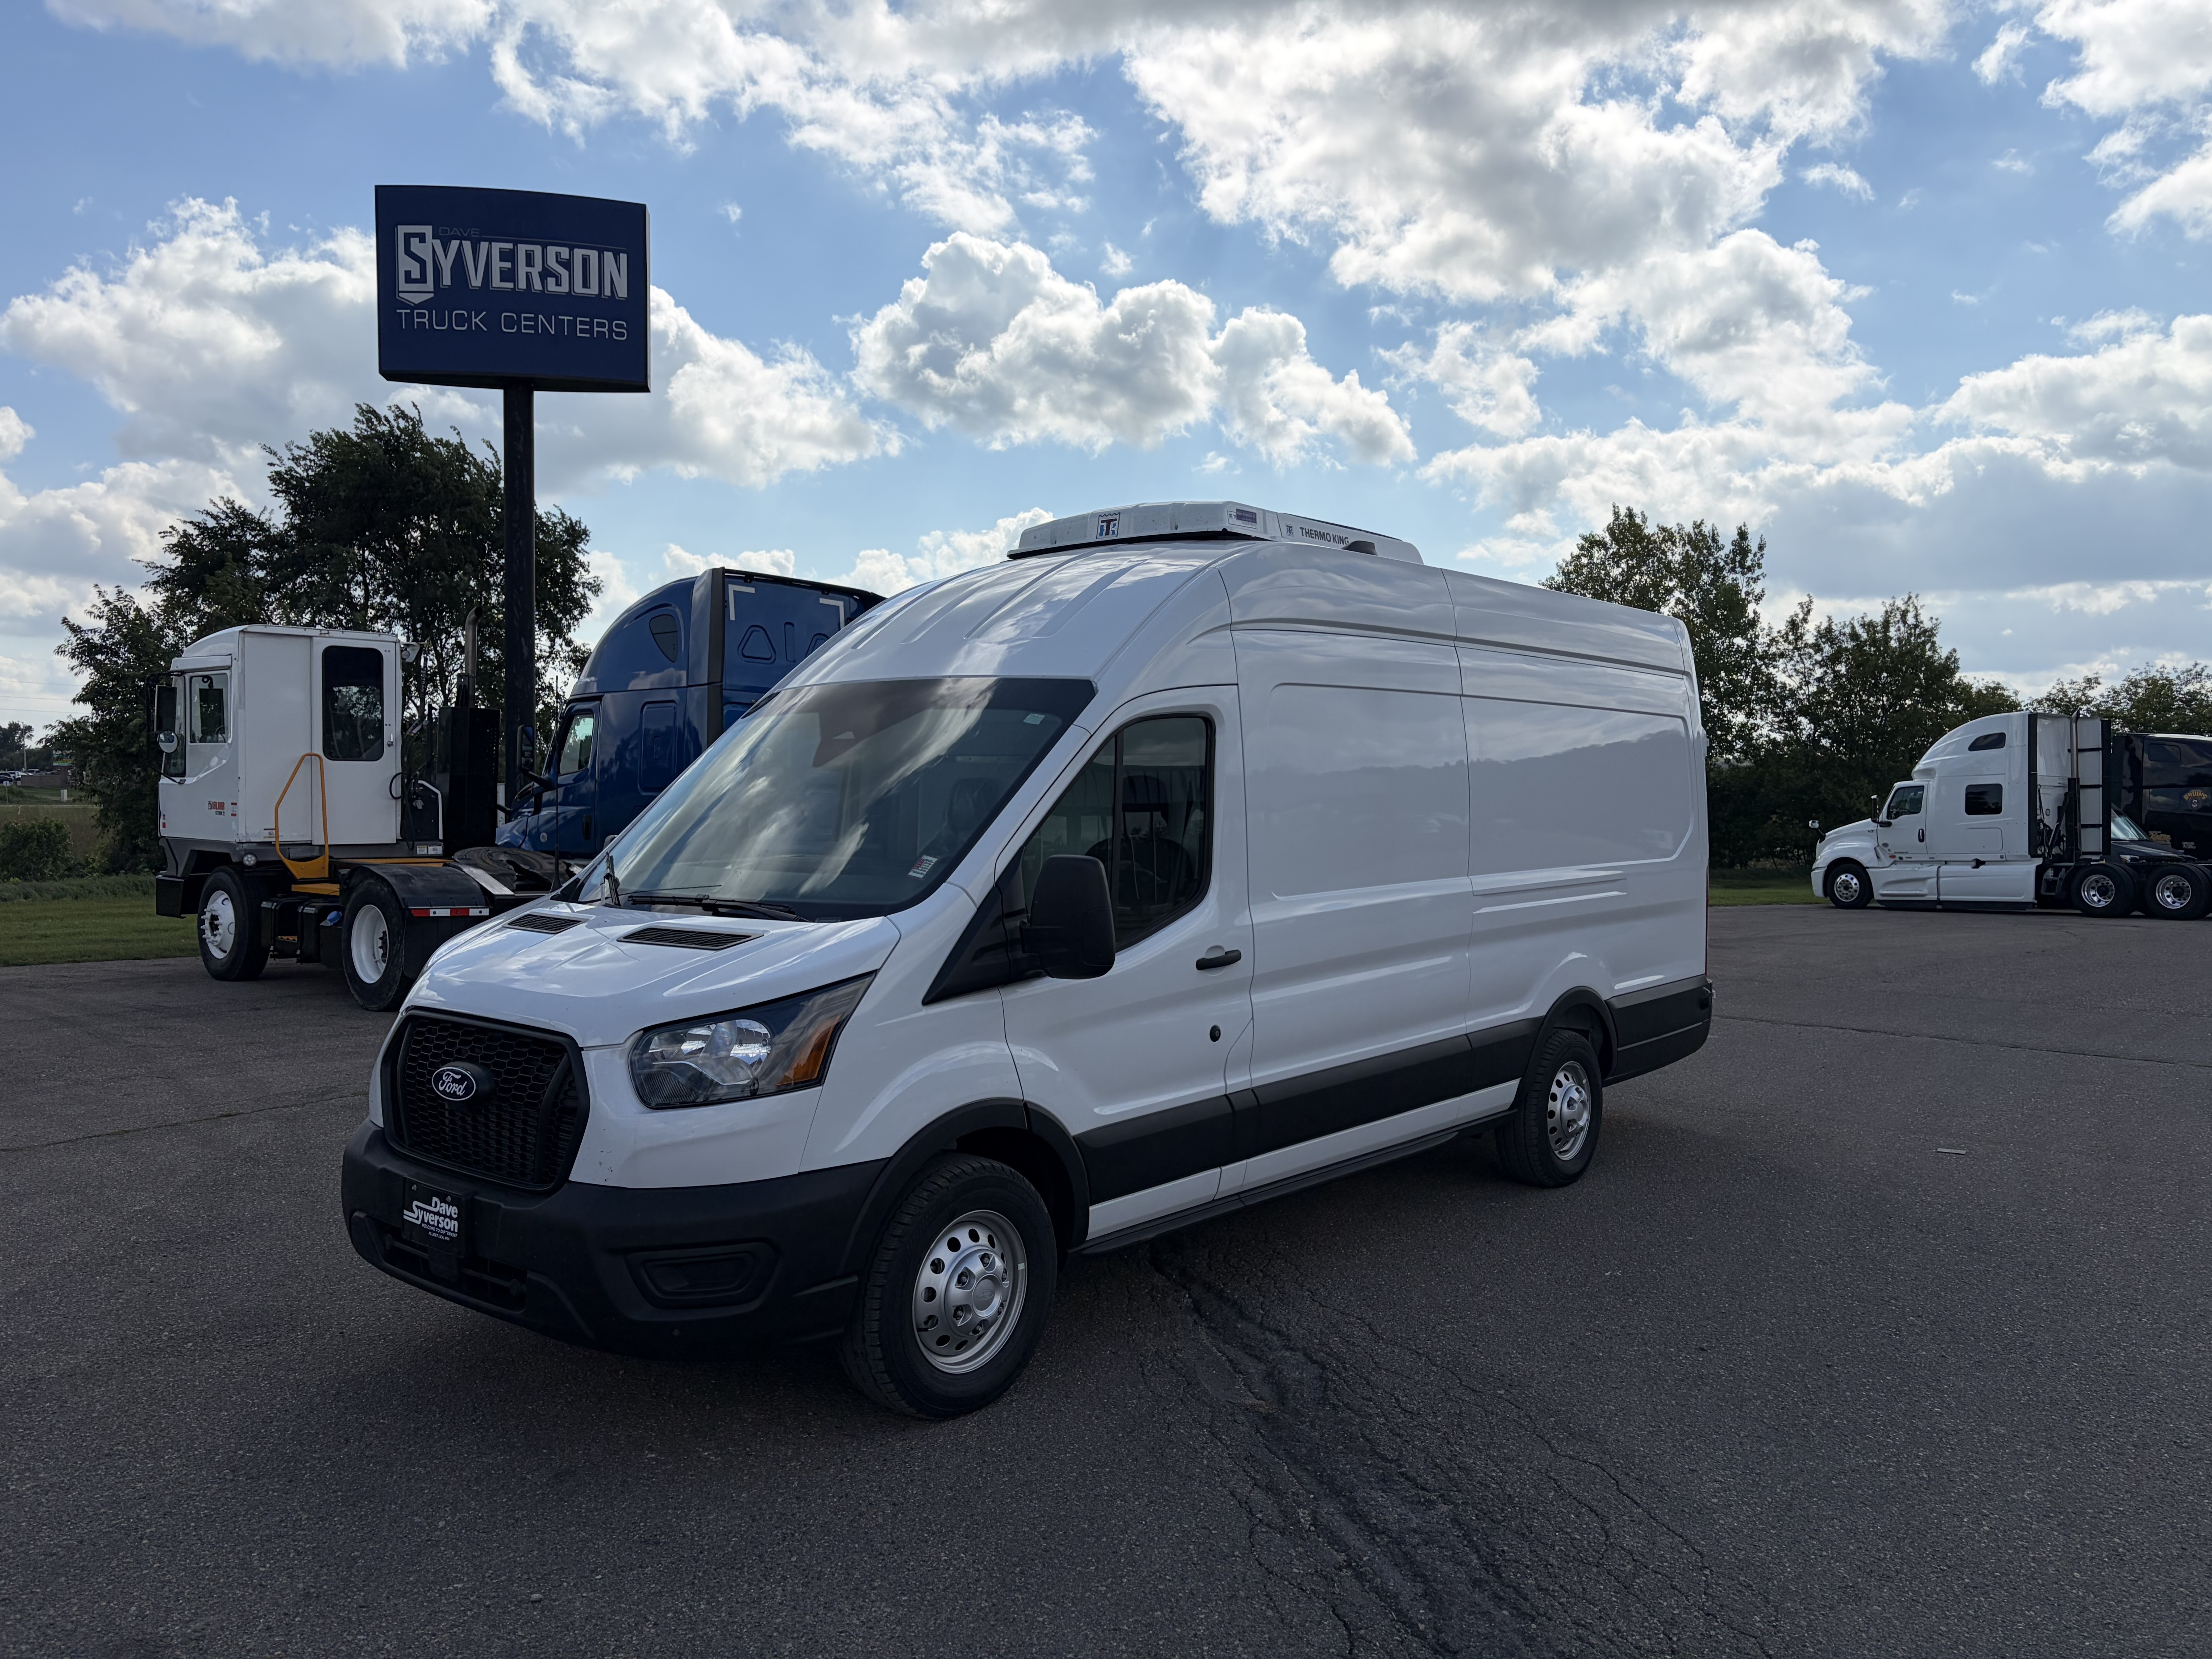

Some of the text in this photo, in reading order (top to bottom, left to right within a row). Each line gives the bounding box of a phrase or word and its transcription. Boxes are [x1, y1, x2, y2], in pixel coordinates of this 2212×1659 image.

[439, 227, 480, 237] DAVE
[396, 225, 628, 305] SYVERSON
[397, 309, 627, 340] TRUCK CENTERS
[1299, 527, 1349, 545] THERMO KING
[2183, 791, 2207, 800] BRUINS
[438, 1071, 467, 1096] Ford
[403, 1200, 458, 1232] Syverson
[432, 1196, 458, 1218] Dave
[421, 1223, 436, 1231] WELCOME
